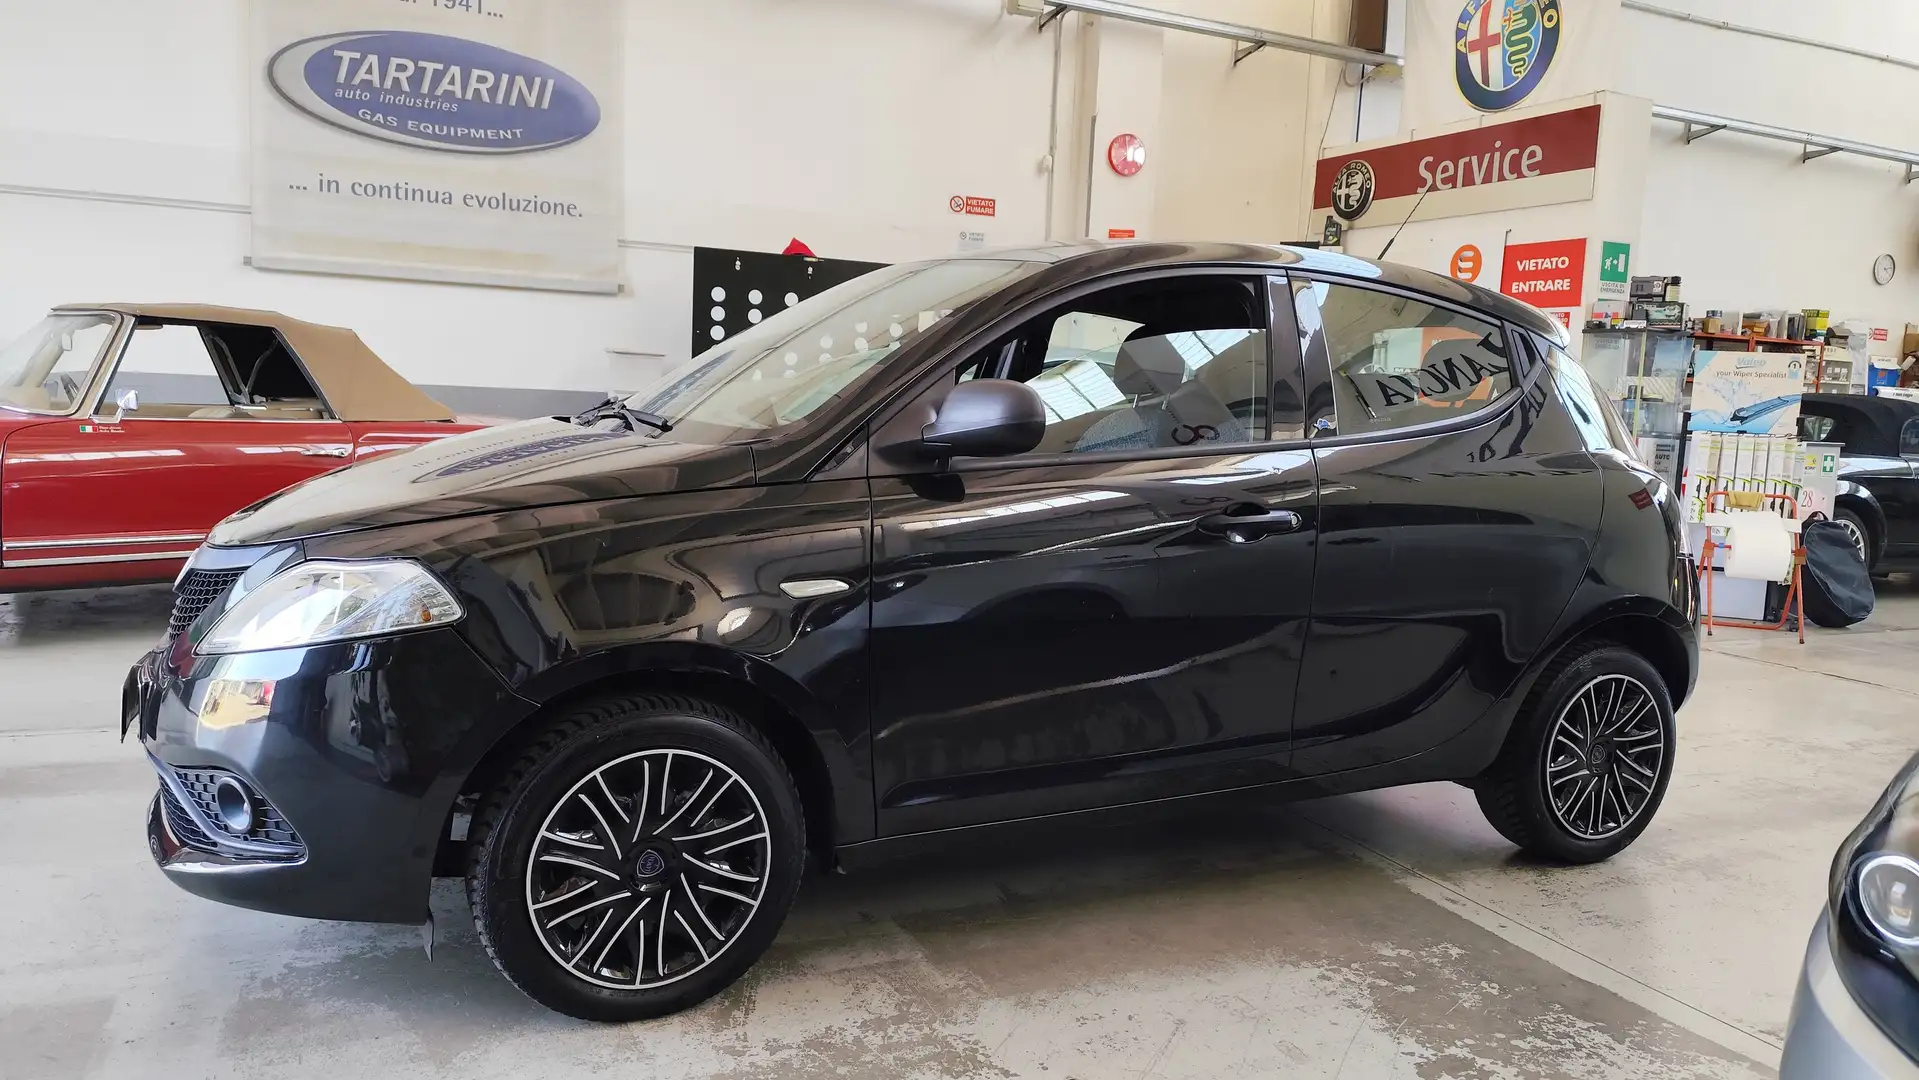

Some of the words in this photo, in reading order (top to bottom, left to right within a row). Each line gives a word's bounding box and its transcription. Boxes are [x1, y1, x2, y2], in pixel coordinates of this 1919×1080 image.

[333, 50, 555, 110] TARTARINI
[334, 87, 370, 101] auto
[379, 91, 459, 112] industries
[357, 108, 398, 127] GAS
[407, 120, 524, 139] EQUIPMENT
[1350, 162, 1371, 189] ROMEO
[1416, 140, 1543, 194] Service
[318, 173, 340, 194] in
[350, 180, 453, 206] continua
[462, 191, 583, 218] evoluzione.
[967, 199, 993, 207] VIETATO
[967, 206, 994, 214] FUMARE
[1516, 256, 1570, 272] VIETATO
[1511, 278, 1571, 294] ENTRARE
[1733, 370, 1753, 378] Wiper
[1754, 371, 1787, 379] Specialist
[1801, 490, 1814, 508] 28
